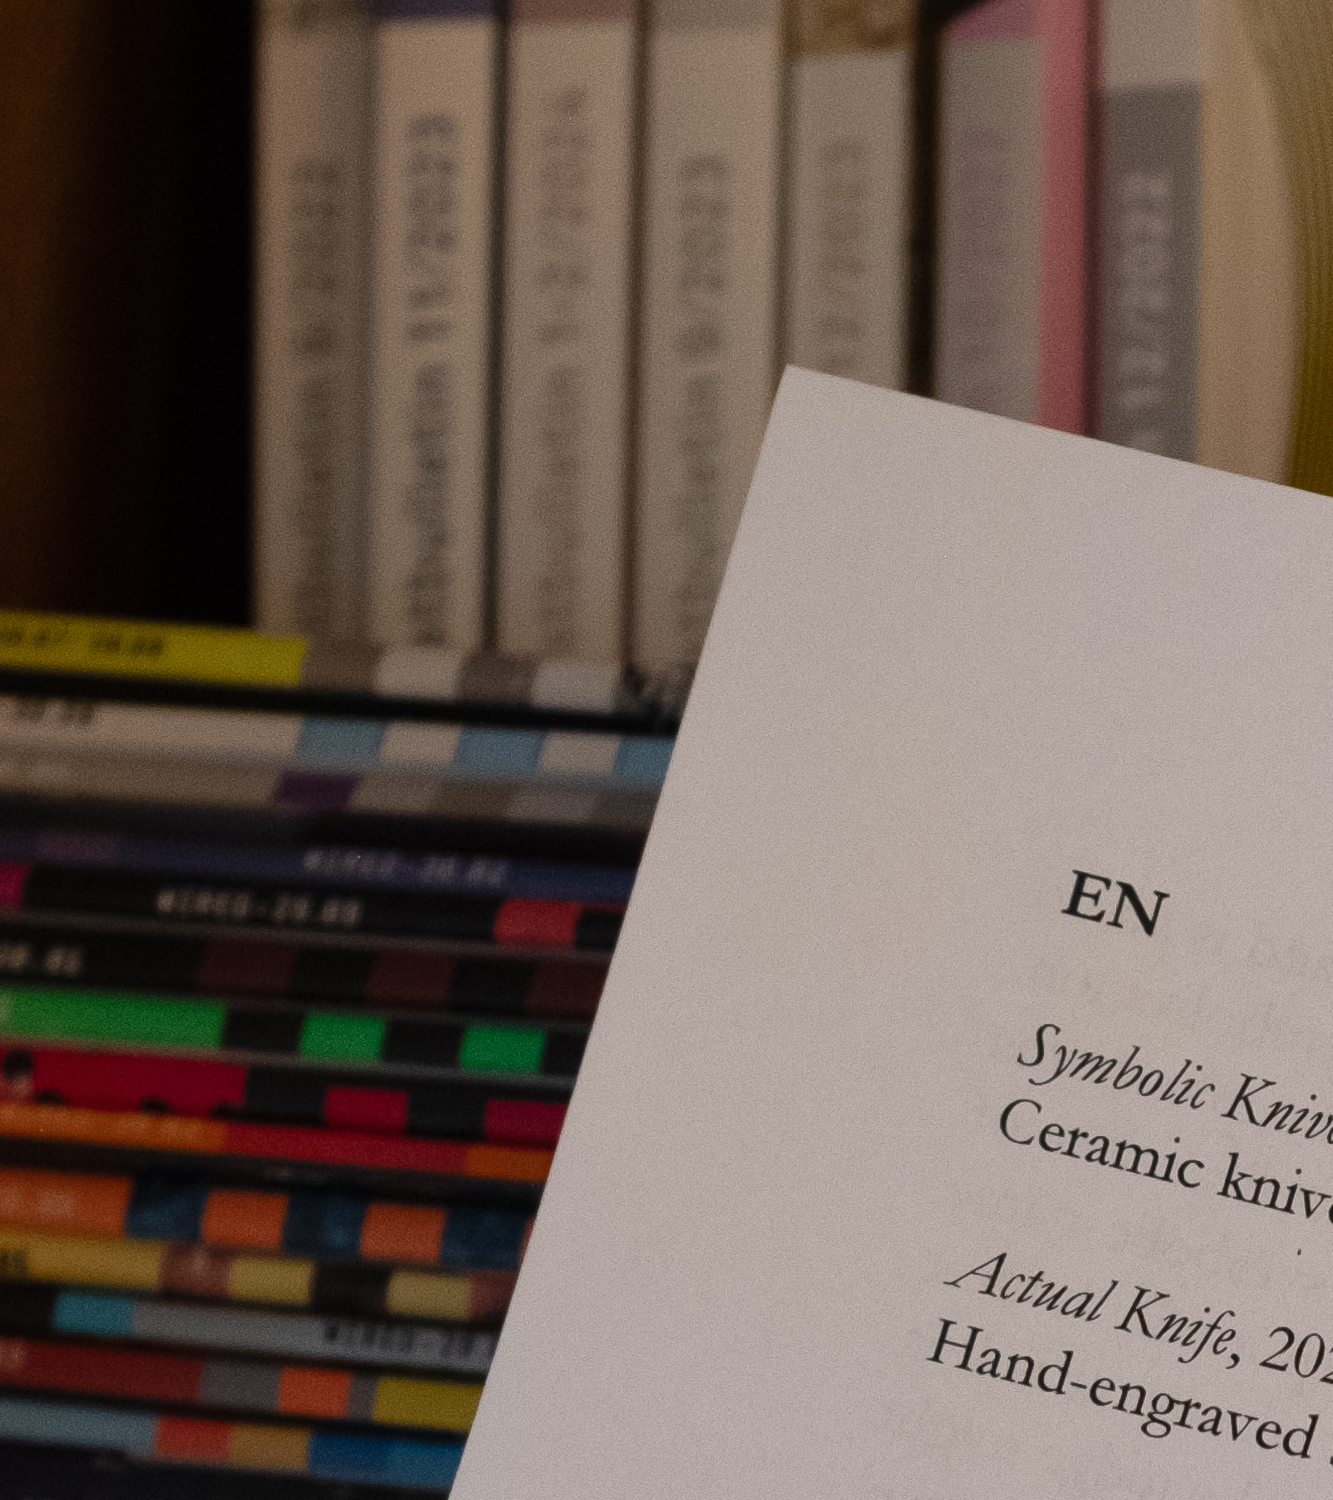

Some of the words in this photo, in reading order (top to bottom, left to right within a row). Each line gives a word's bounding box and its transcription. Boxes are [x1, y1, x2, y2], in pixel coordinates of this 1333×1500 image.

[1059, 867, 1172, 939] EN
[1014, 1021, 1218, 1112] Symbolic
[997, 1096, 1207, 1191] Ceramic
[941, 1250, 1121, 1324] Actual
[1112, 1283, 1242, 1372] Knife,
[925, 1316, 1321, 1461] Hand-engraved
